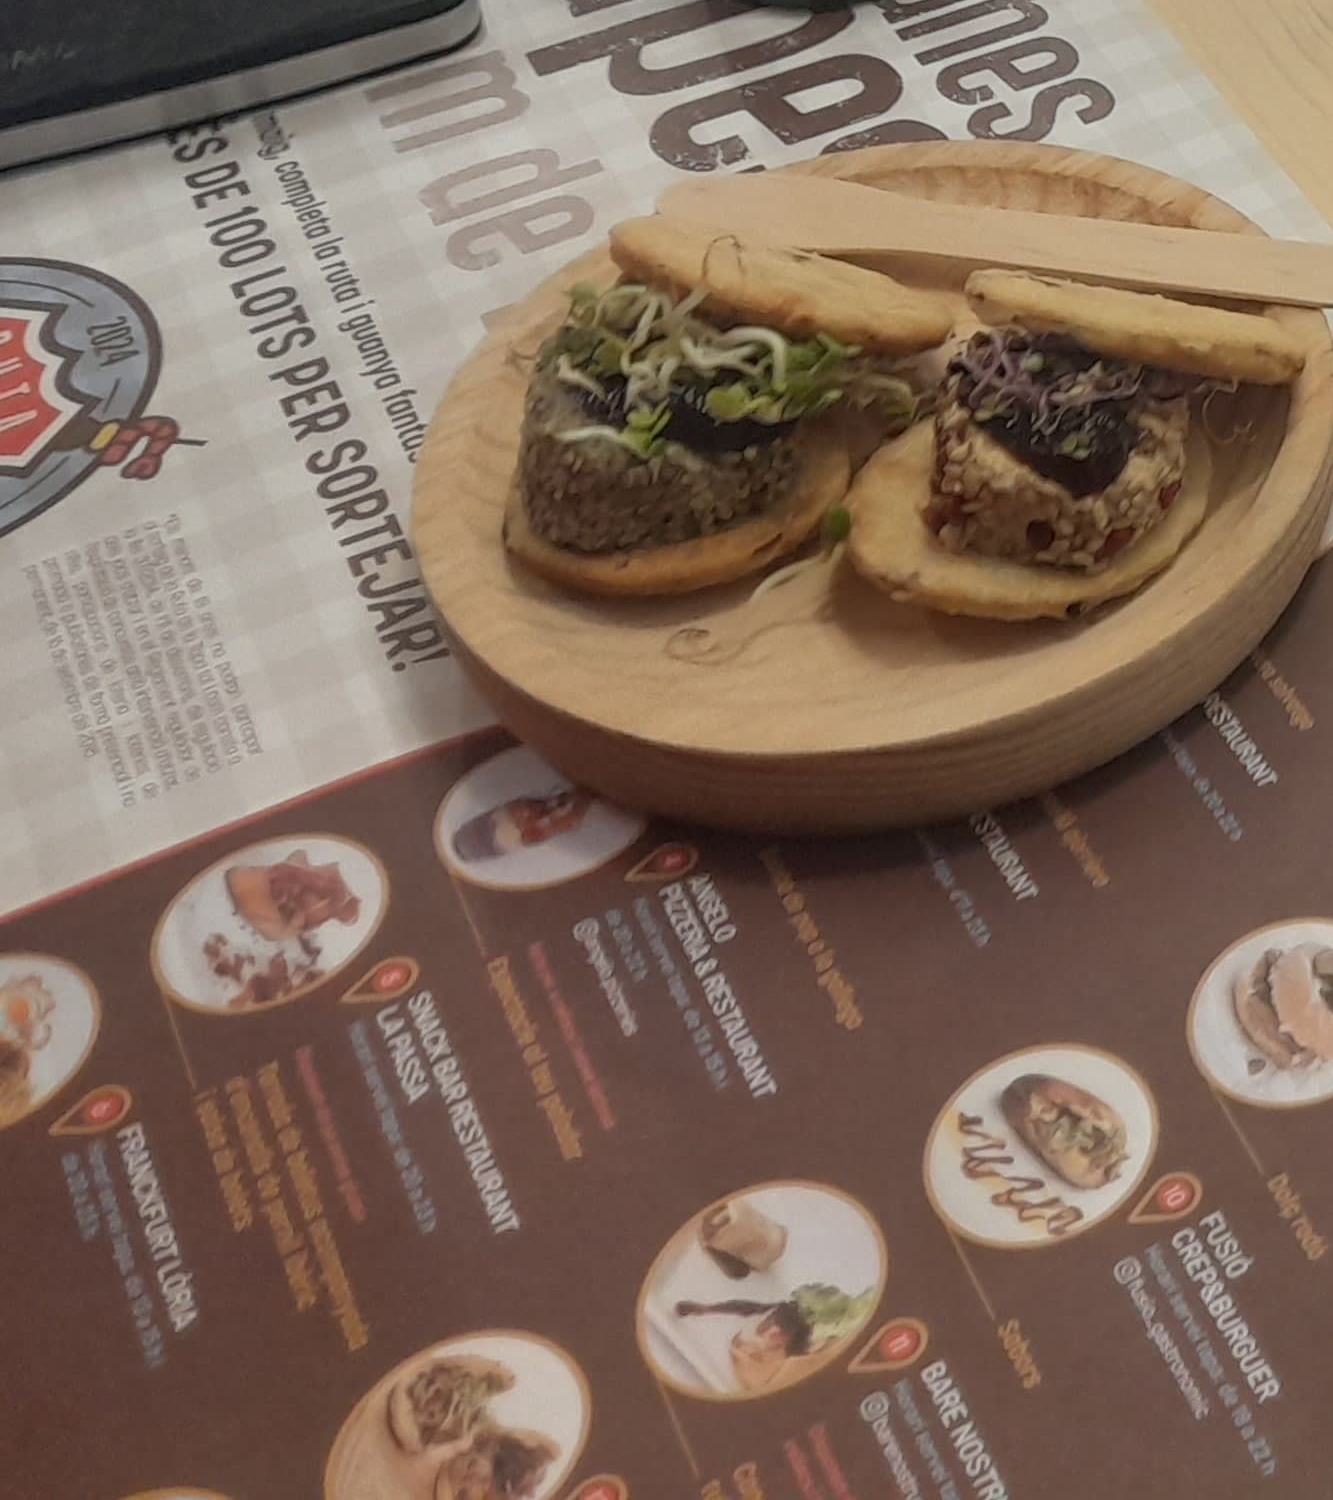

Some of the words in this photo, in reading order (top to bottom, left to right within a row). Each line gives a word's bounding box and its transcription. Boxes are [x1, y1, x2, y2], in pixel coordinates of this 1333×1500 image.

[182, 161, 252, 209] DE
[264, 158, 338, 242] completa
[414, 152, 604, 269] de
[200, 205, 279, 270] 100
[310, 237, 351, 261] la
[227, 270, 320, 361] LOTS
[318, 259, 367, 304] ruta
[87, 316, 139, 366] 2024
[335, 313, 402, 393] guanya
[264, 357, 354, 442] PER
[299, 438, 458, 675] SORTEJAR!
[655, 881, 714, 962] PIZZERIA
[684, 872, 740, 945] ANGELO
[691, 957, 718, 977] &
[372, 1004, 406, 1039] LA
[403, 990, 453, 1063] SNACK
[697, 972, 780, 1101] RESTAURANT
[382, 1032, 432, 1106] PASSA
[430, 1057, 469, 1106] BAR
[445, 1098, 522, 1238] RESTAURANT
[1195, 1207, 1258, 1281] FUSIÓ
[153, 1257, 204, 1335] LÒRIA
[1165, 1225, 1285, 1404] CREP&BURGUER
[917, 1359, 970, 1428] BARE
[947, 1420, 1008, 1500] NOSTR
